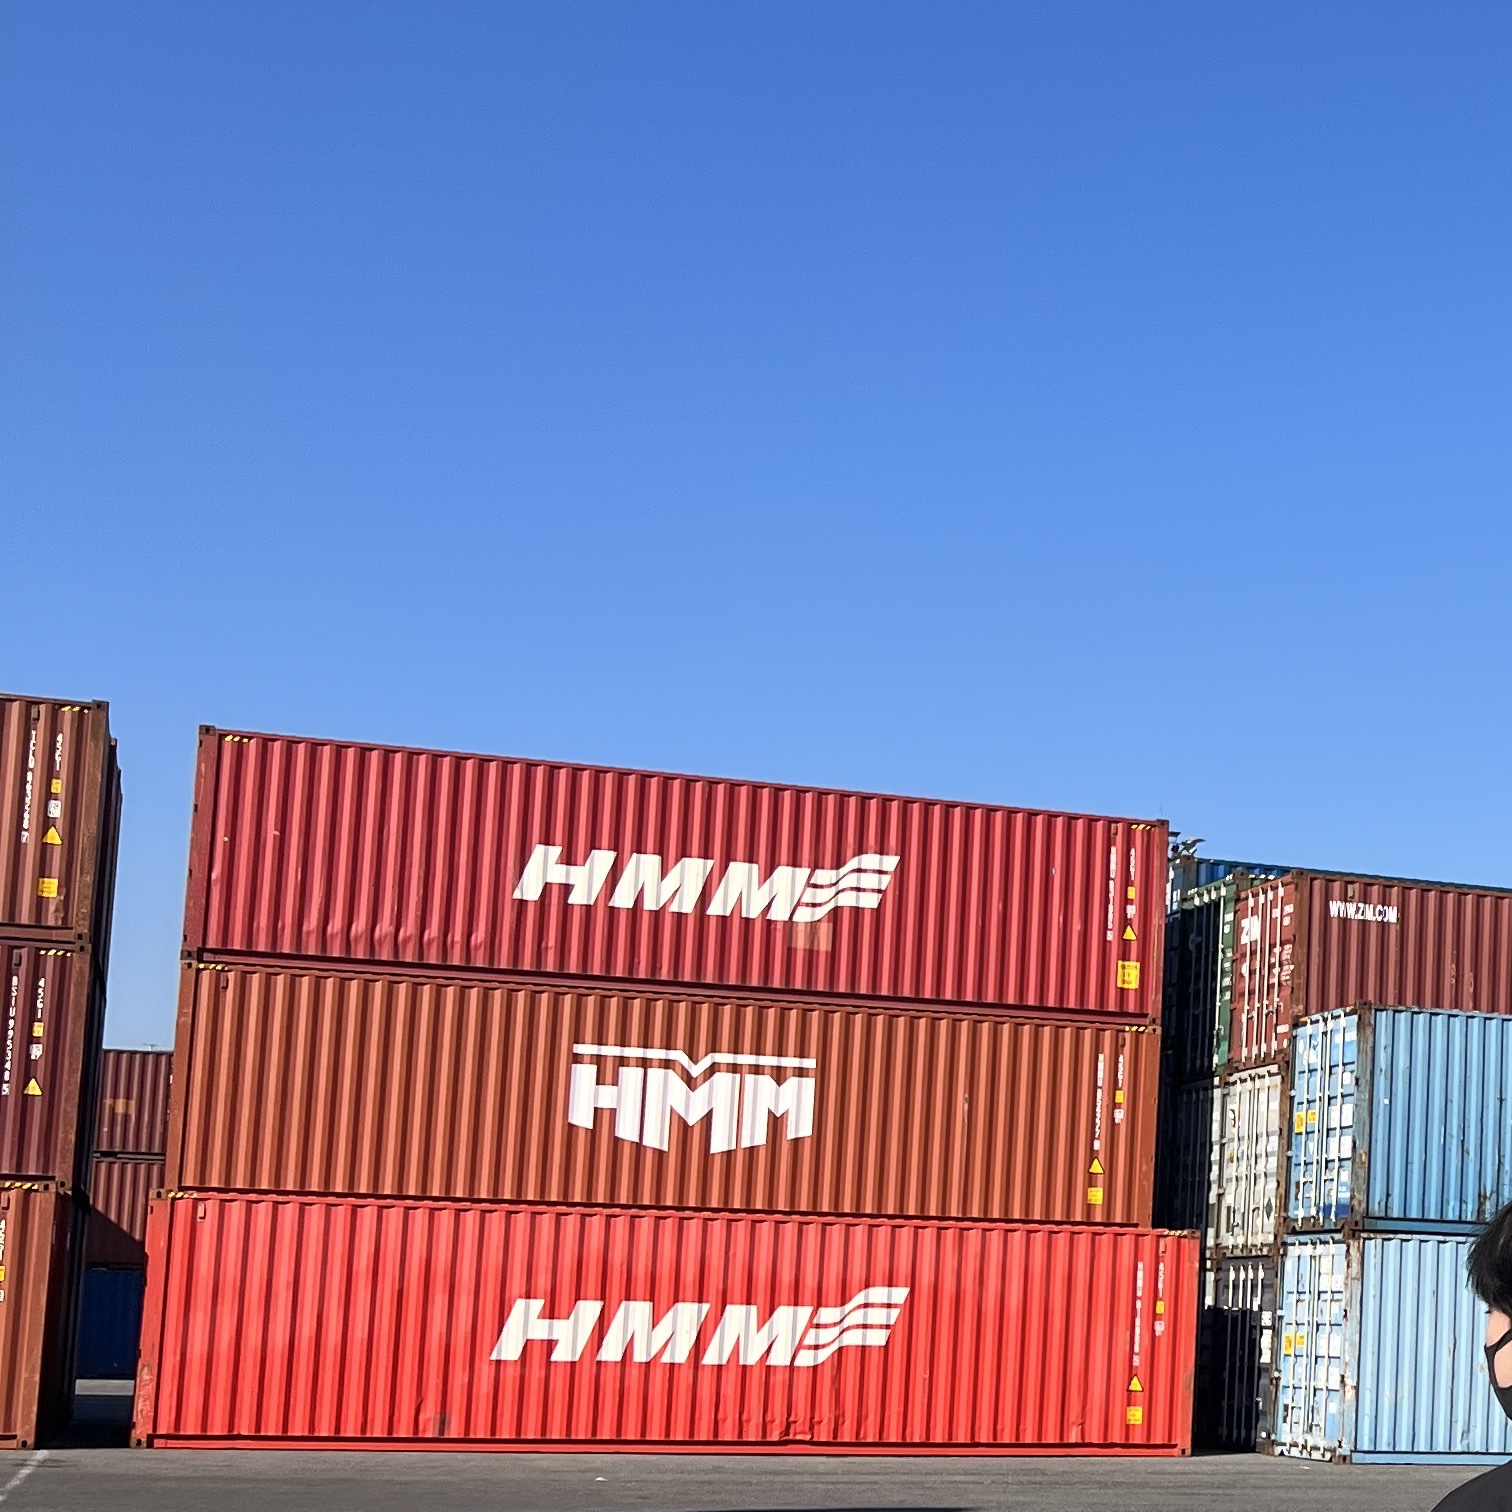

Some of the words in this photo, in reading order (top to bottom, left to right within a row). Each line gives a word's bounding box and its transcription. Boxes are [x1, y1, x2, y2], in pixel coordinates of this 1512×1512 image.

[512, 844, 818, 922] HMM
[1329, 900, 1398, 924] WWW.ZIM.COM
[568, 1060, 816, 1154] HMM
[490, 1297, 818, 1367] HMM
